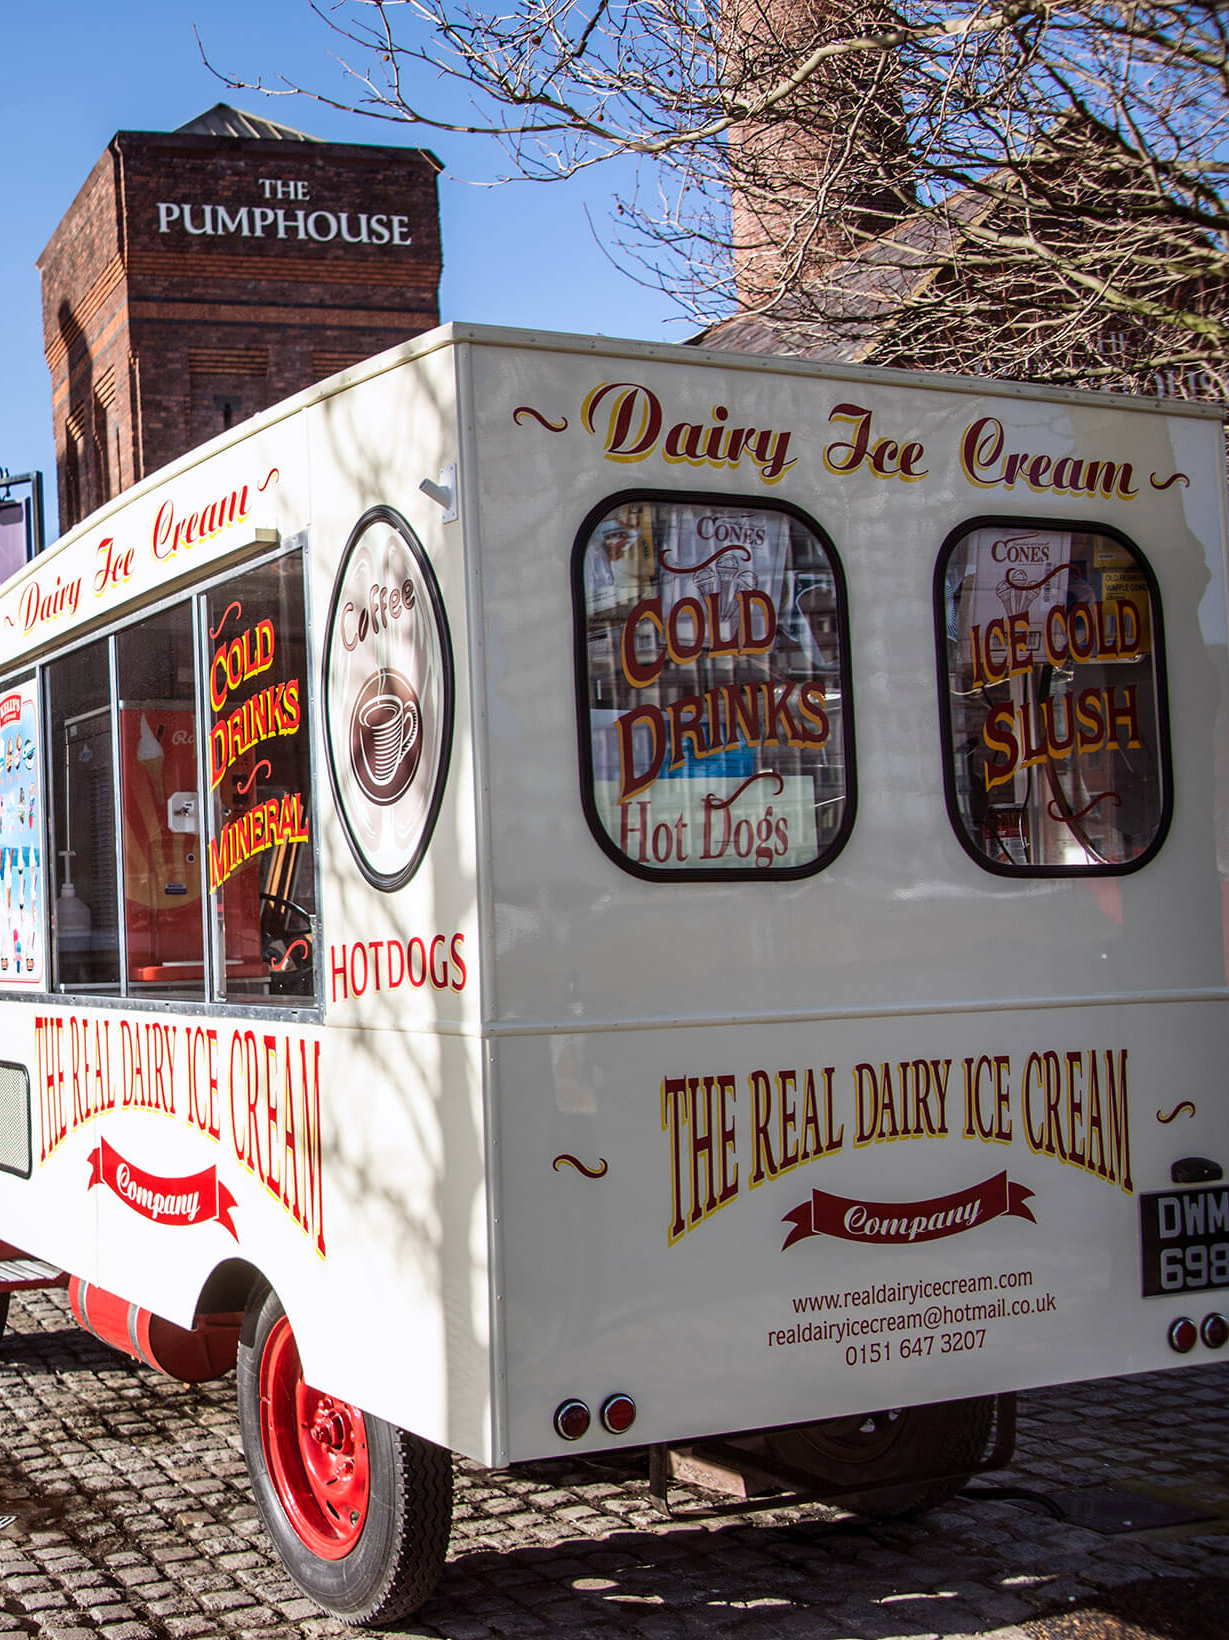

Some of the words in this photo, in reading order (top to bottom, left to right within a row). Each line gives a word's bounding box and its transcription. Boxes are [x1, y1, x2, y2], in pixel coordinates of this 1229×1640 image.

[156, 202, 413, 246] PUMPHOUSE
[258, 178, 311, 201] THE
[581, 382, 799, 486] Dairy
[822, 402, 930, 483] Ice
[959, 416, 1140, 501] Cream
[19, 576, 83, 636] Dairy
[93, 537, 136, 599] Ice
[151, 485, 252, 563] Cream
[697, 516, 766, 546] CONES
[991, 540, 1050, 563] CONES
[341, 578, 416, 652] Coffee
[622, 589, 777, 689] COLD
[969, 610, 1034, 689] ICE
[1043, 599, 1141, 667] COLD
[210, 618, 275, 713] COLD
[209, 678, 301, 793] DRINKS
[613, 681, 830, 806] DRINKS
[983, 684, 1142, 793] SLUSH
[207, 793, 309, 896] MINERAL
[619, 801, 689, 864] Hot
[699, 797, 790, 869] Dogs
[329, 931, 468, 1004] HOTDOGS
[34, 1015, 68, 1167] THE
[69, 1015, 116, 1133] REAL
[119, 1019, 178, 1119] DAIRY
[185, 1025, 221, 1144] ICE
[227, 1028, 327, 1262] CREAM
[660, 1074, 741, 1247] THE
[747, 1066, 845, 1191] REAL
[852, 1058, 953, 1150] DAIRY
[961, 1054, 1013, 1145] ICE
[1021, 1048, 1135, 1196] CREAM
[115, 1162, 202, 1221] Company
[843, 1196, 983, 1241] Company
[1157, 1191, 1229, 1239] DWM
[791, 1270, 1033, 1314] www.realdairyicecream.com
[1160, 1242, 1229, 1290] 698
[766, 1292, 1057, 1347] realdairyicecream@hotmail.co.uk
[844, 1342, 891, 1366] 0151
[899, 1335, 935, 1359] 647
[939, 1328, 987, 1353] 3207
